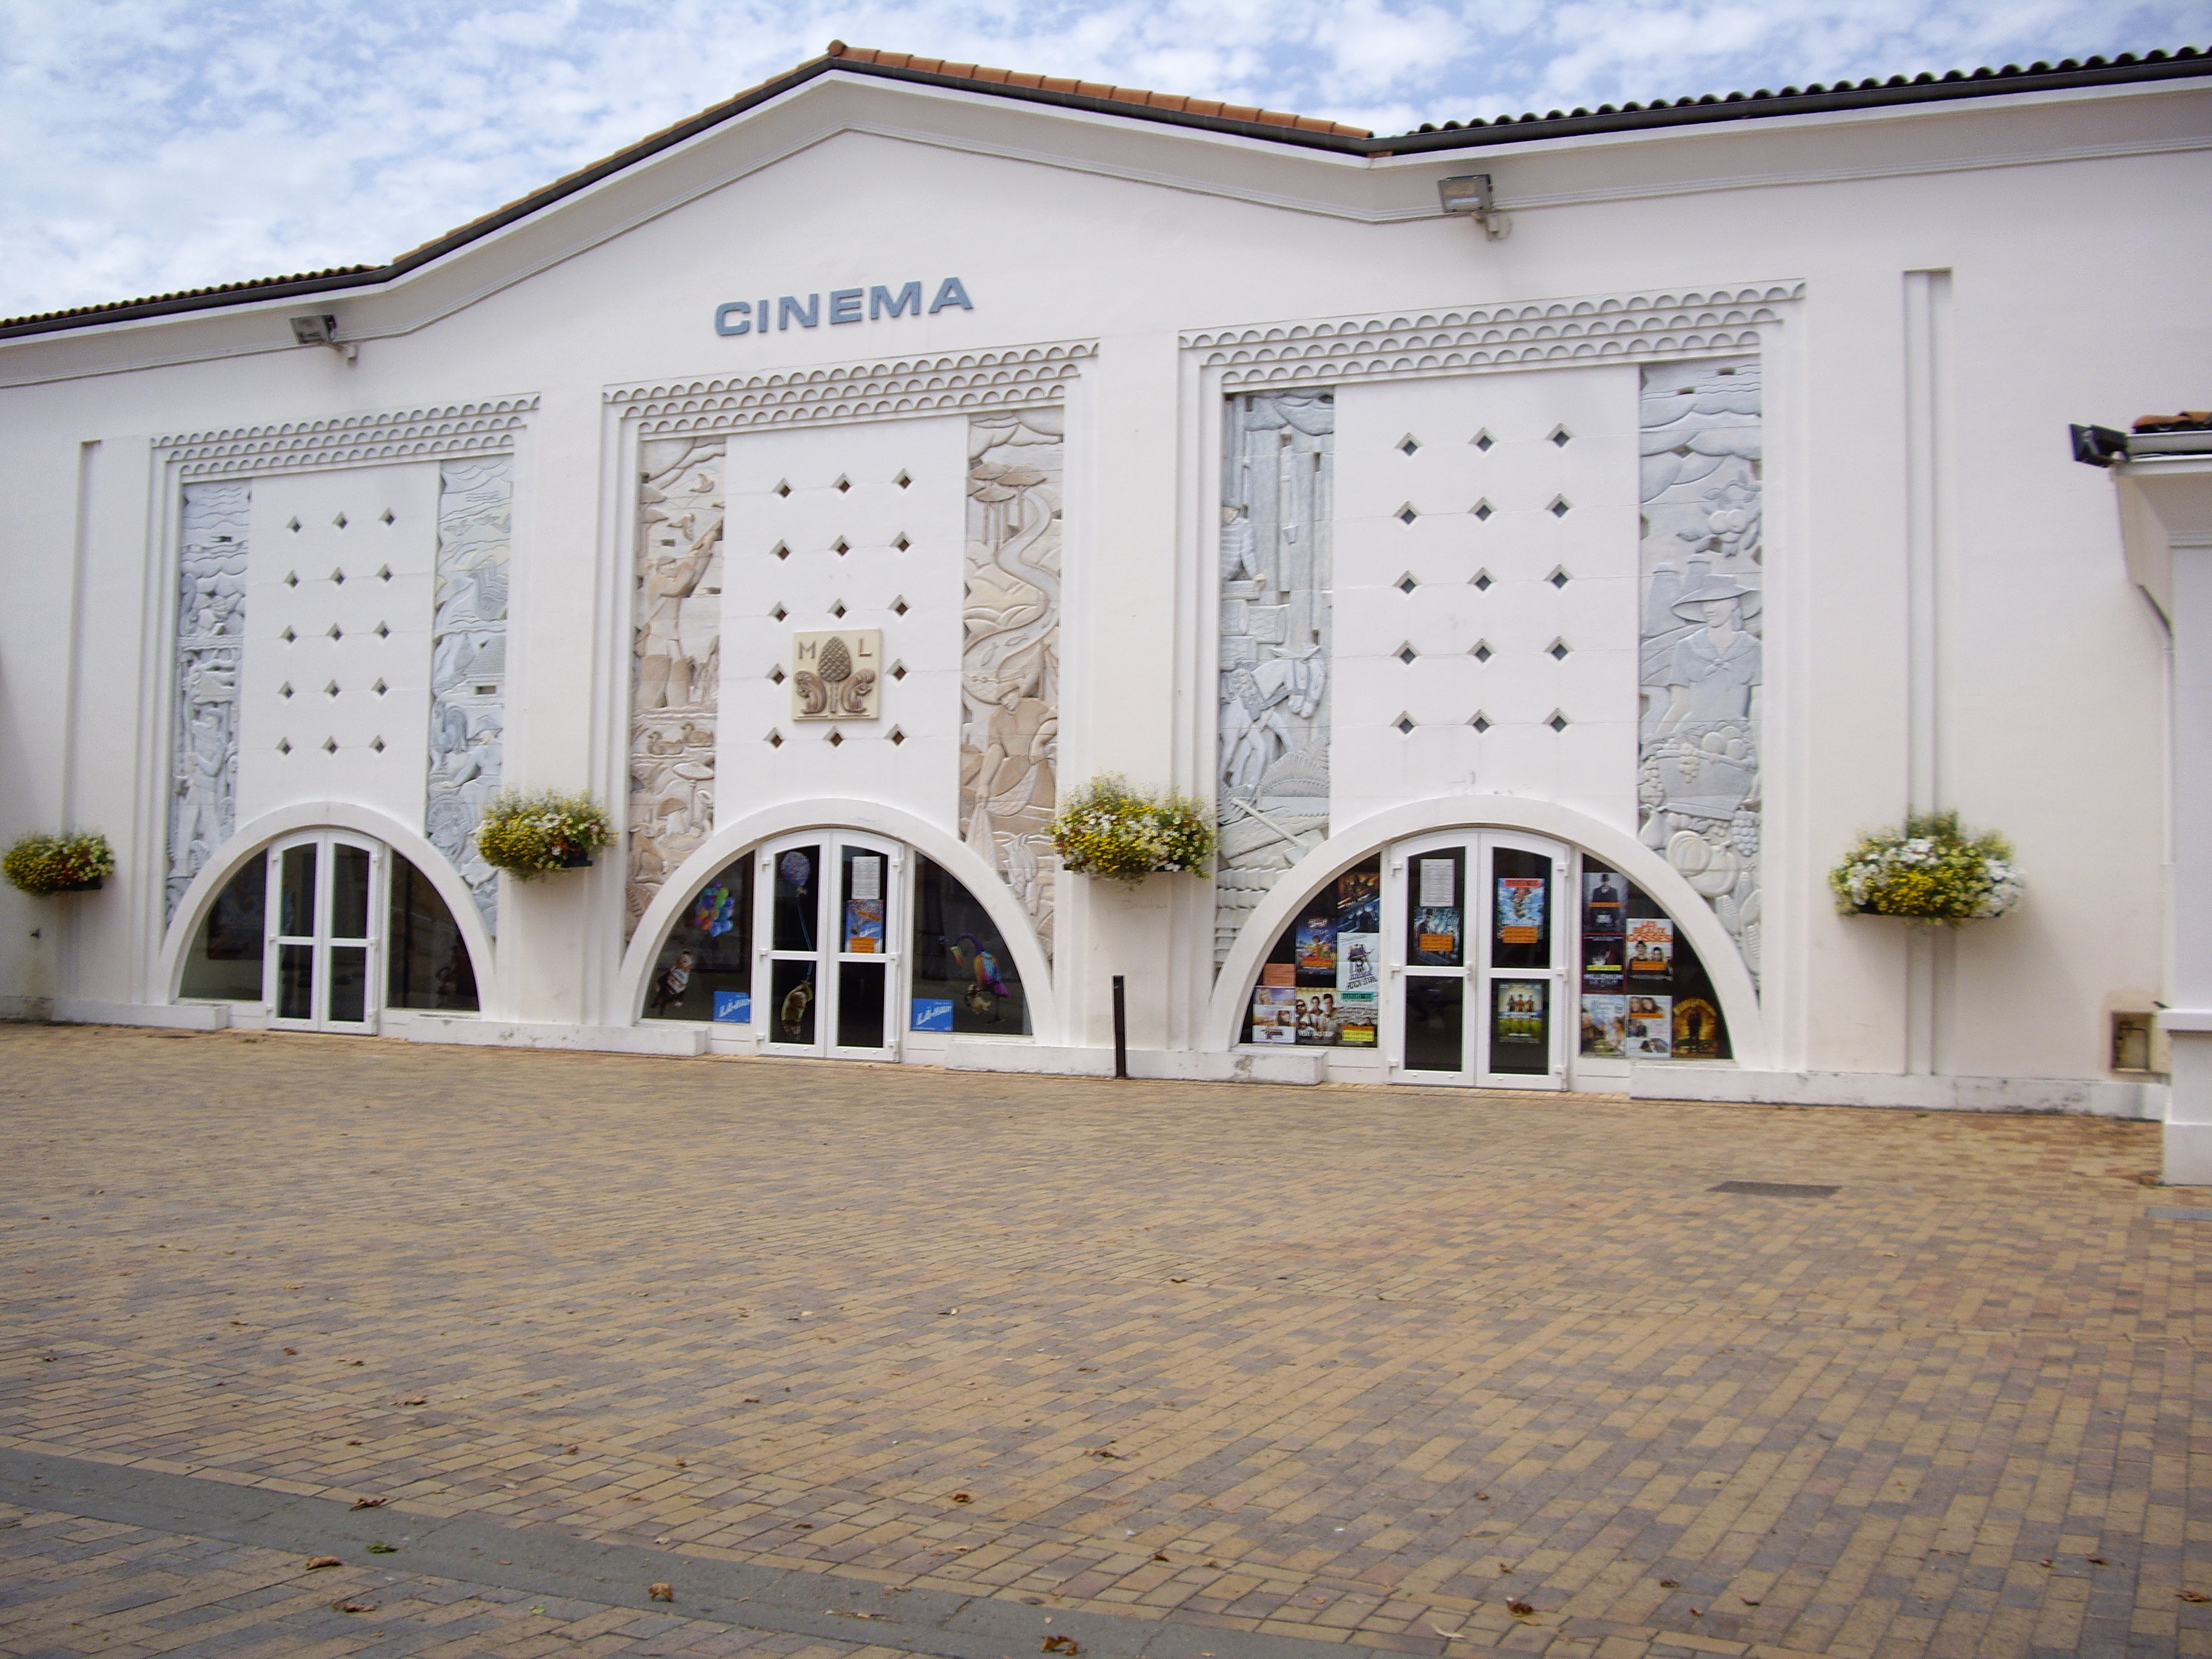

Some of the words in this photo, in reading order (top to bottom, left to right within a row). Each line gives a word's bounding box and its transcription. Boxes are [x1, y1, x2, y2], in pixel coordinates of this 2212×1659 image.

[714, 276, 974, 336] CINEMA
[798, 640, 817, 659] M
[858, 638, 872, 657] L
